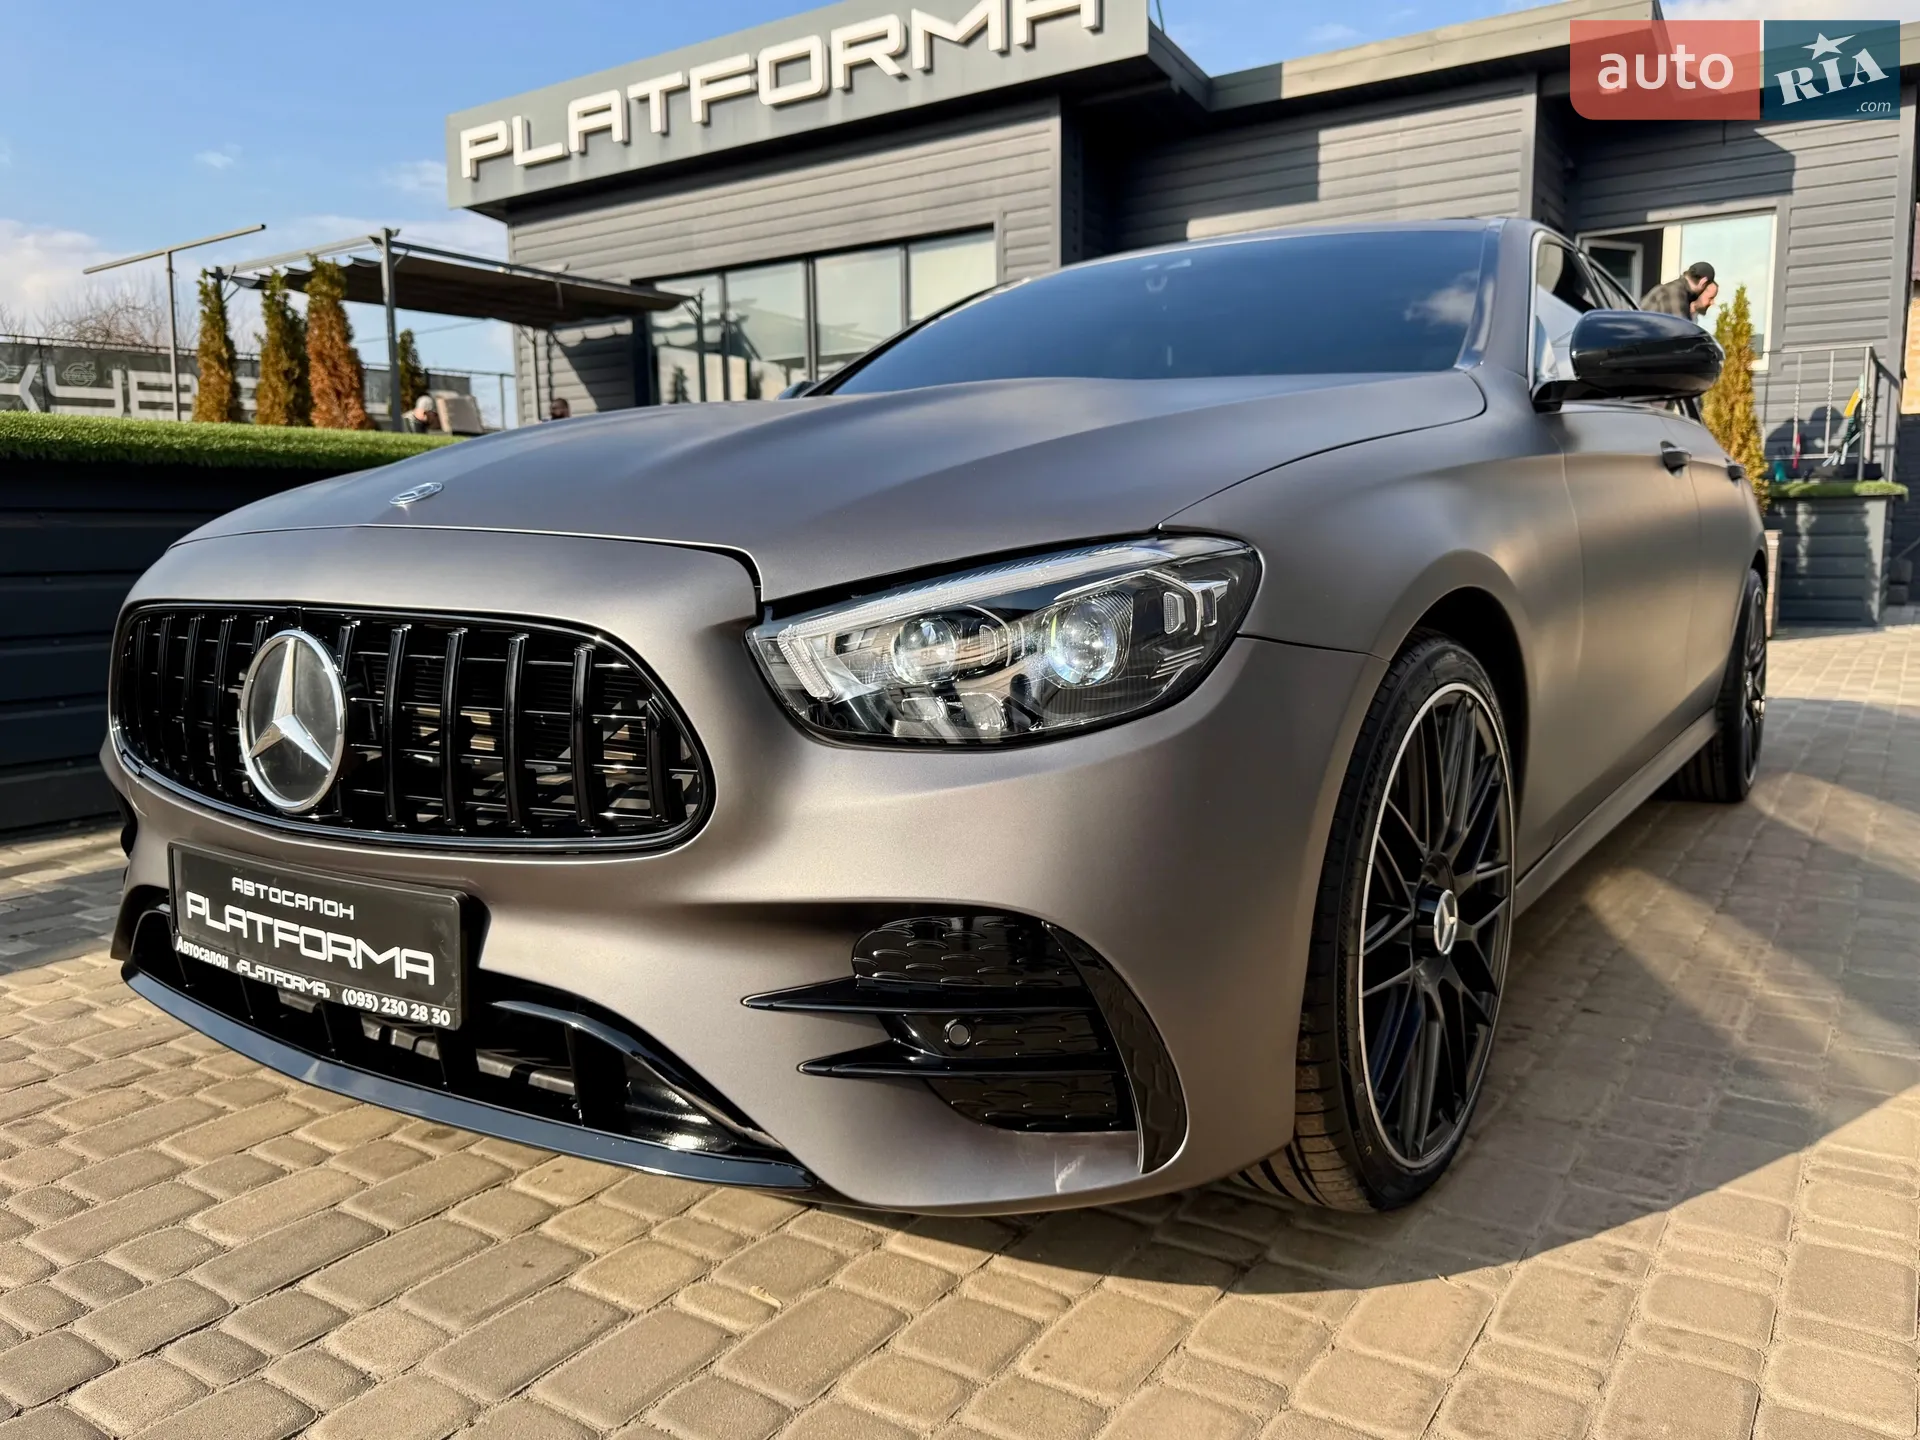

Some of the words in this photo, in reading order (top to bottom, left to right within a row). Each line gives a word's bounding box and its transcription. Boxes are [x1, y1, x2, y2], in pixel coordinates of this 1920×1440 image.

[459, 0, 1103, 179] PLATFORMA
[185, 891, 436, 985] PLATFORMA
[231, 876, 355, 920] АВТОСАЛОН
[175, 936, 229, 969] Автосалон
[341, 988, 379, 1012] (093)
[381, 997, 408, 1017] 230
[410, 1003, 429, 1022] 28
[431, 1007, 451, 1026] 30
